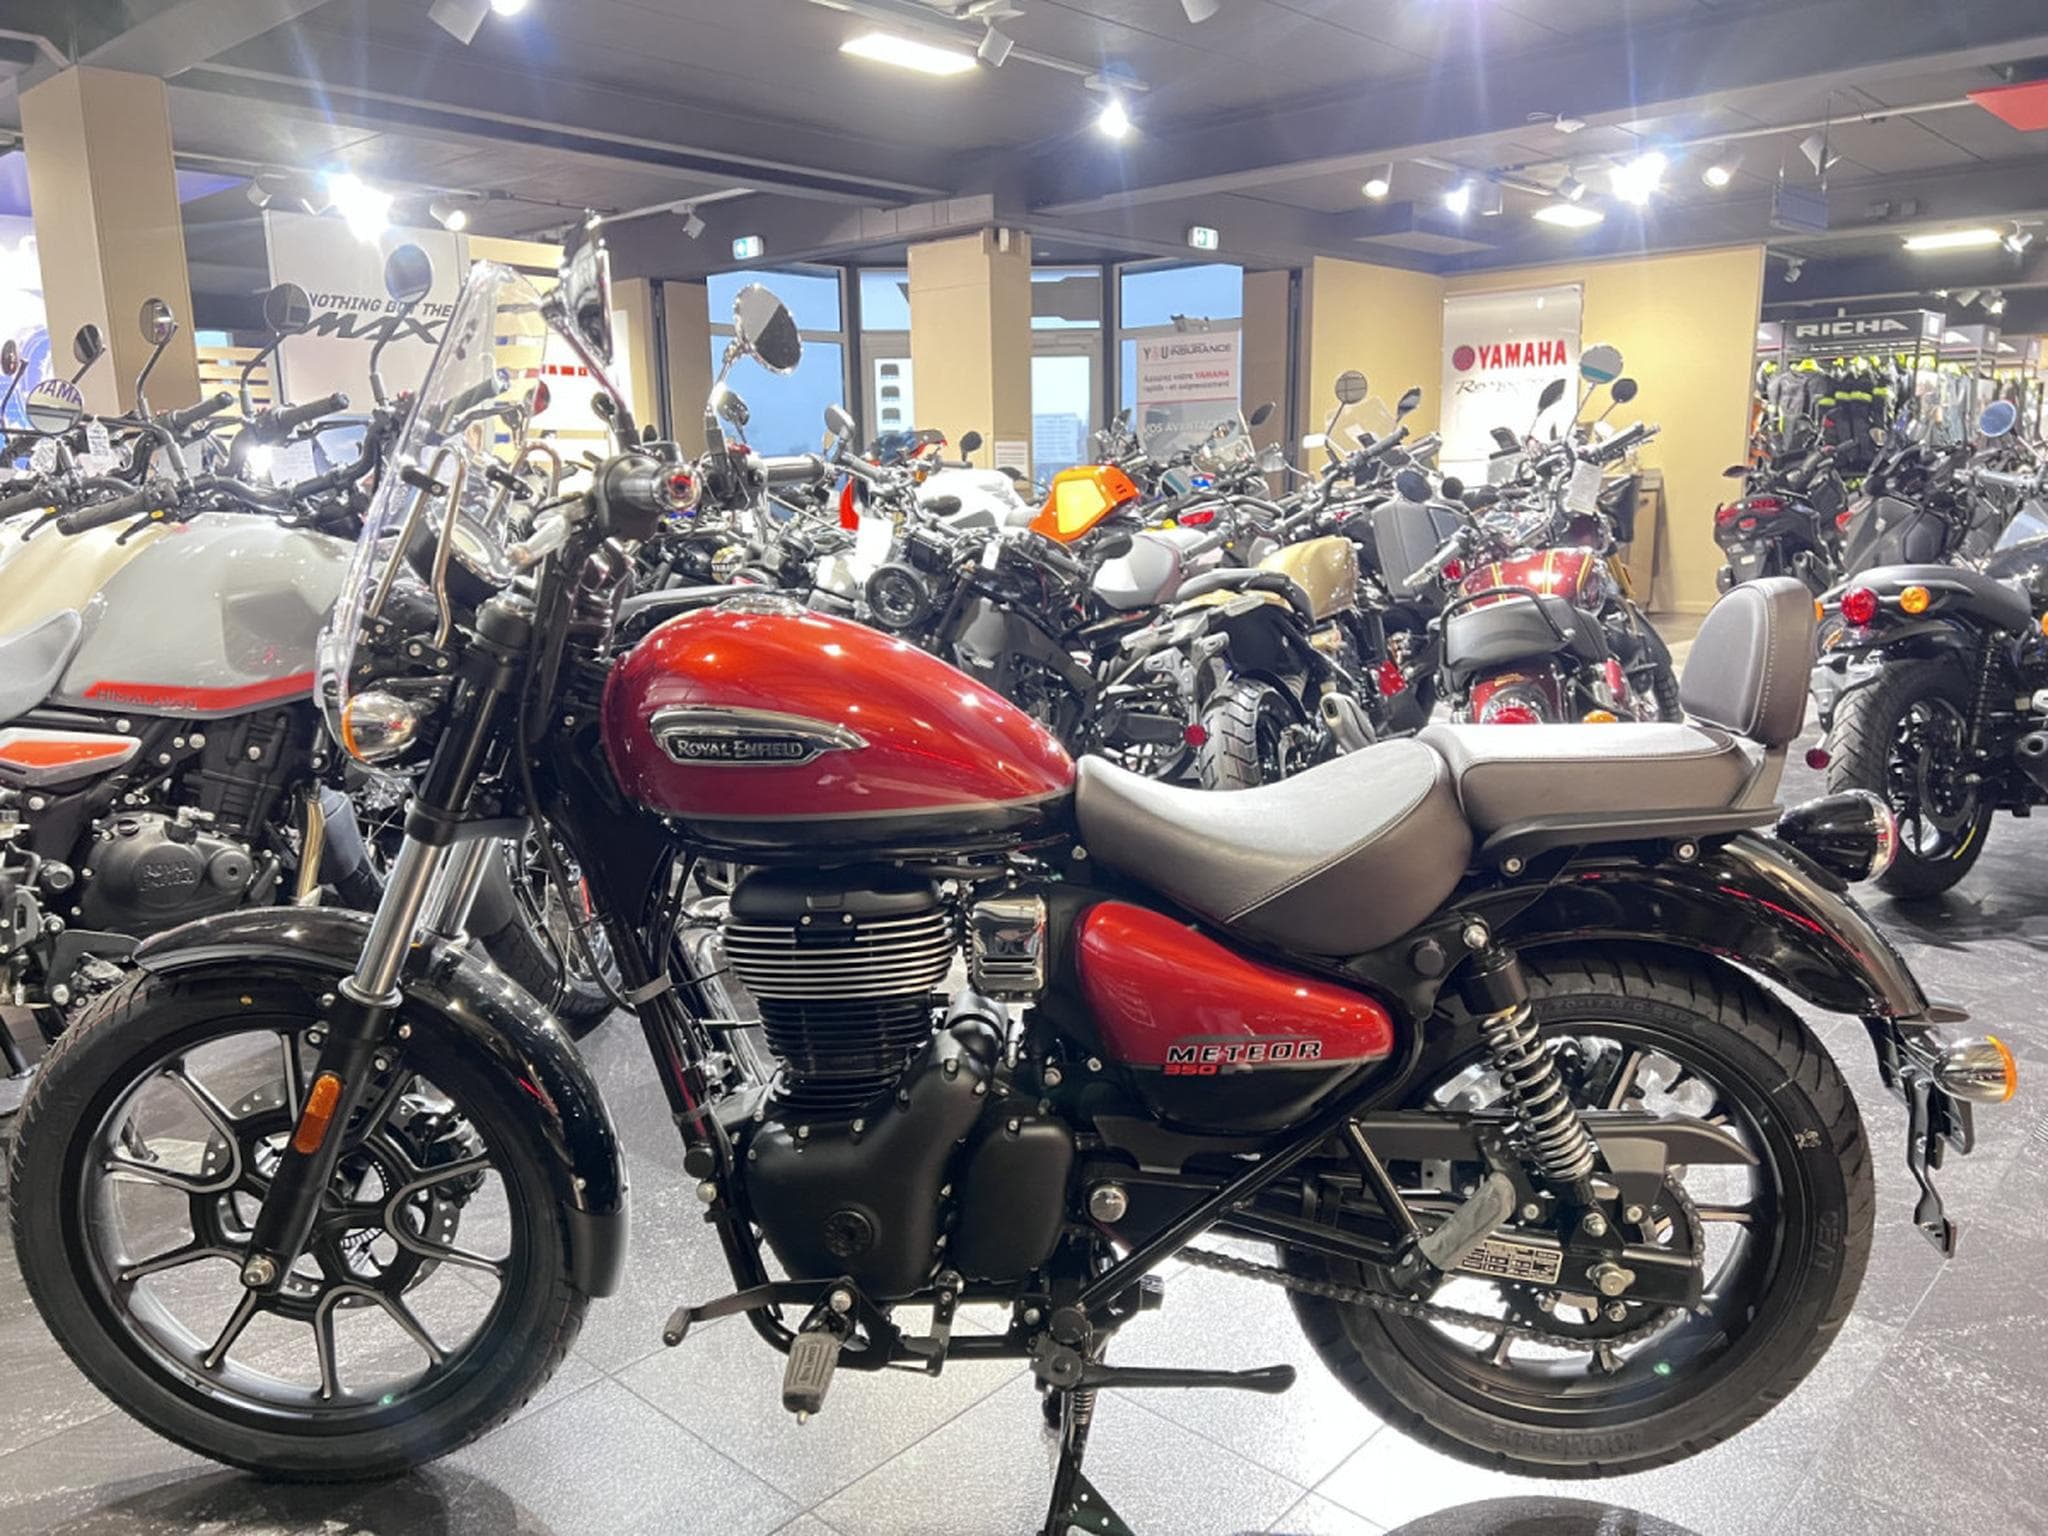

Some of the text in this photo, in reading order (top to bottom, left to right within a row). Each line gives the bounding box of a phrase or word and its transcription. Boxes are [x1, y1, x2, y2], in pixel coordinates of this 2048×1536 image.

[309, 292, 382, 313] NOTHING
[422, 302, 454, 318] THE
[301, 311, 448, 345] MAX
[1796, 319, 1909, 338] RICHA
[1478, 339, 1567, 370] YAMAHA
[677, 739, 803, 758] ROYAL ENFIELD
[1166, 1040, 1322, 1064] METEOR
[1163, 1063, 1219, 1077] 350
